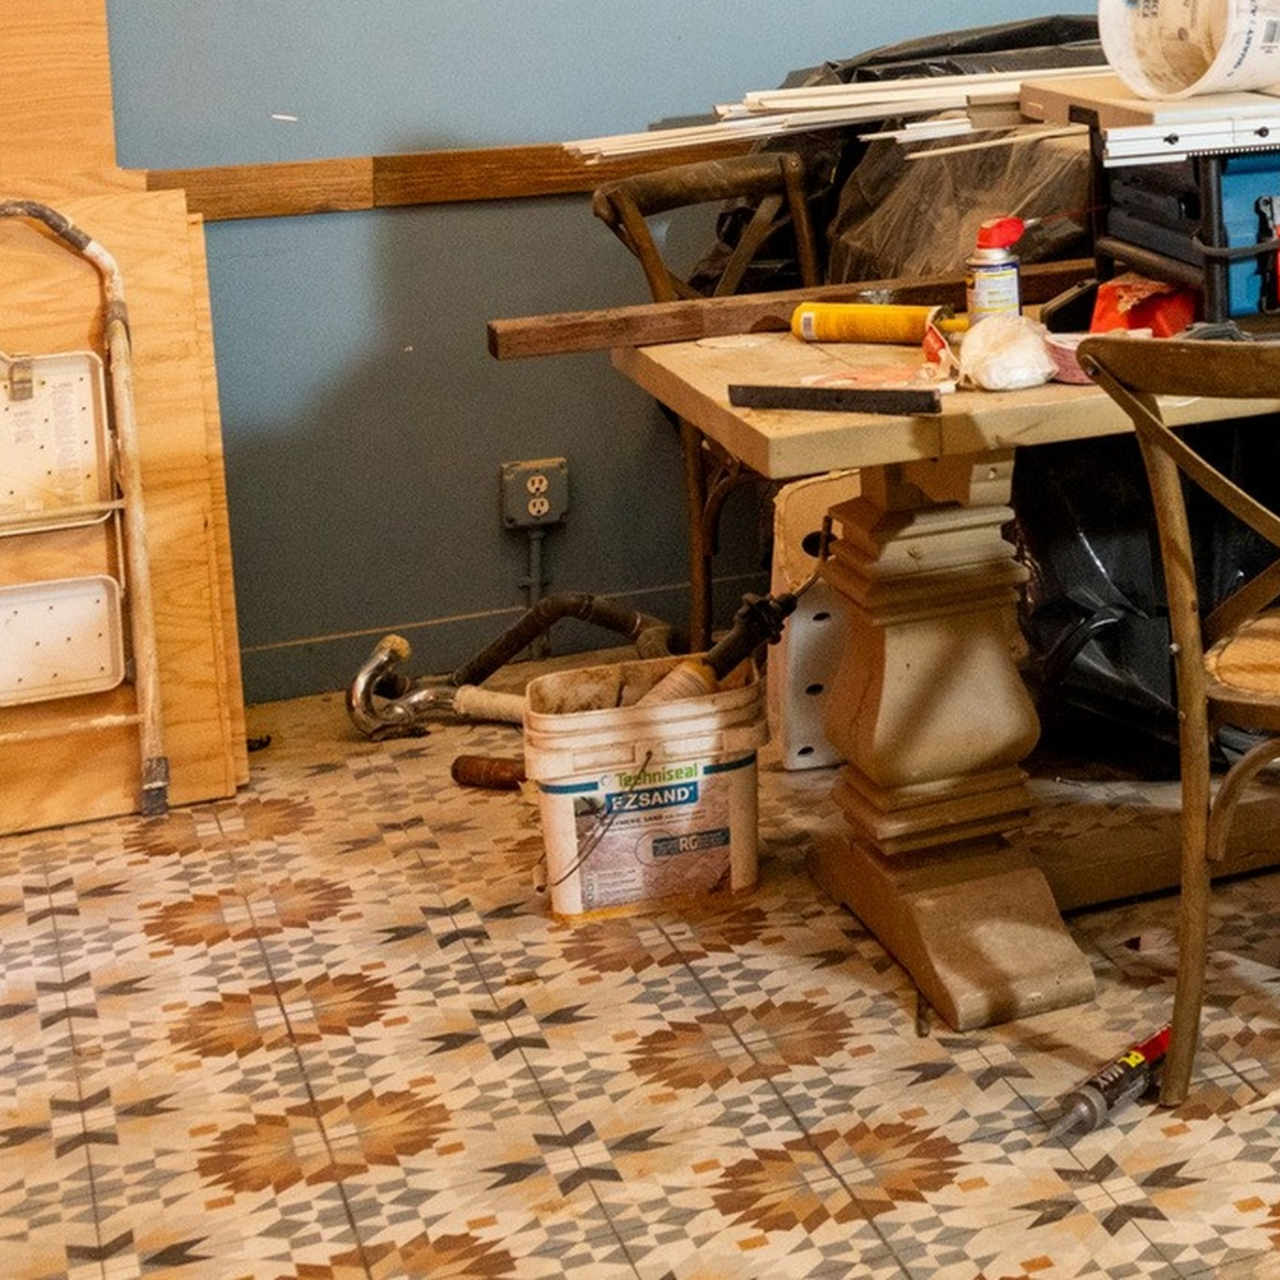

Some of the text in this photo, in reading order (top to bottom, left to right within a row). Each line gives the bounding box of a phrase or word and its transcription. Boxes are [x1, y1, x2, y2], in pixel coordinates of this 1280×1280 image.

[615, 763, 698, 787] Techniseal
[612, 786, 690, 810] EZSAND
[679, 835, 698, 851] RG
